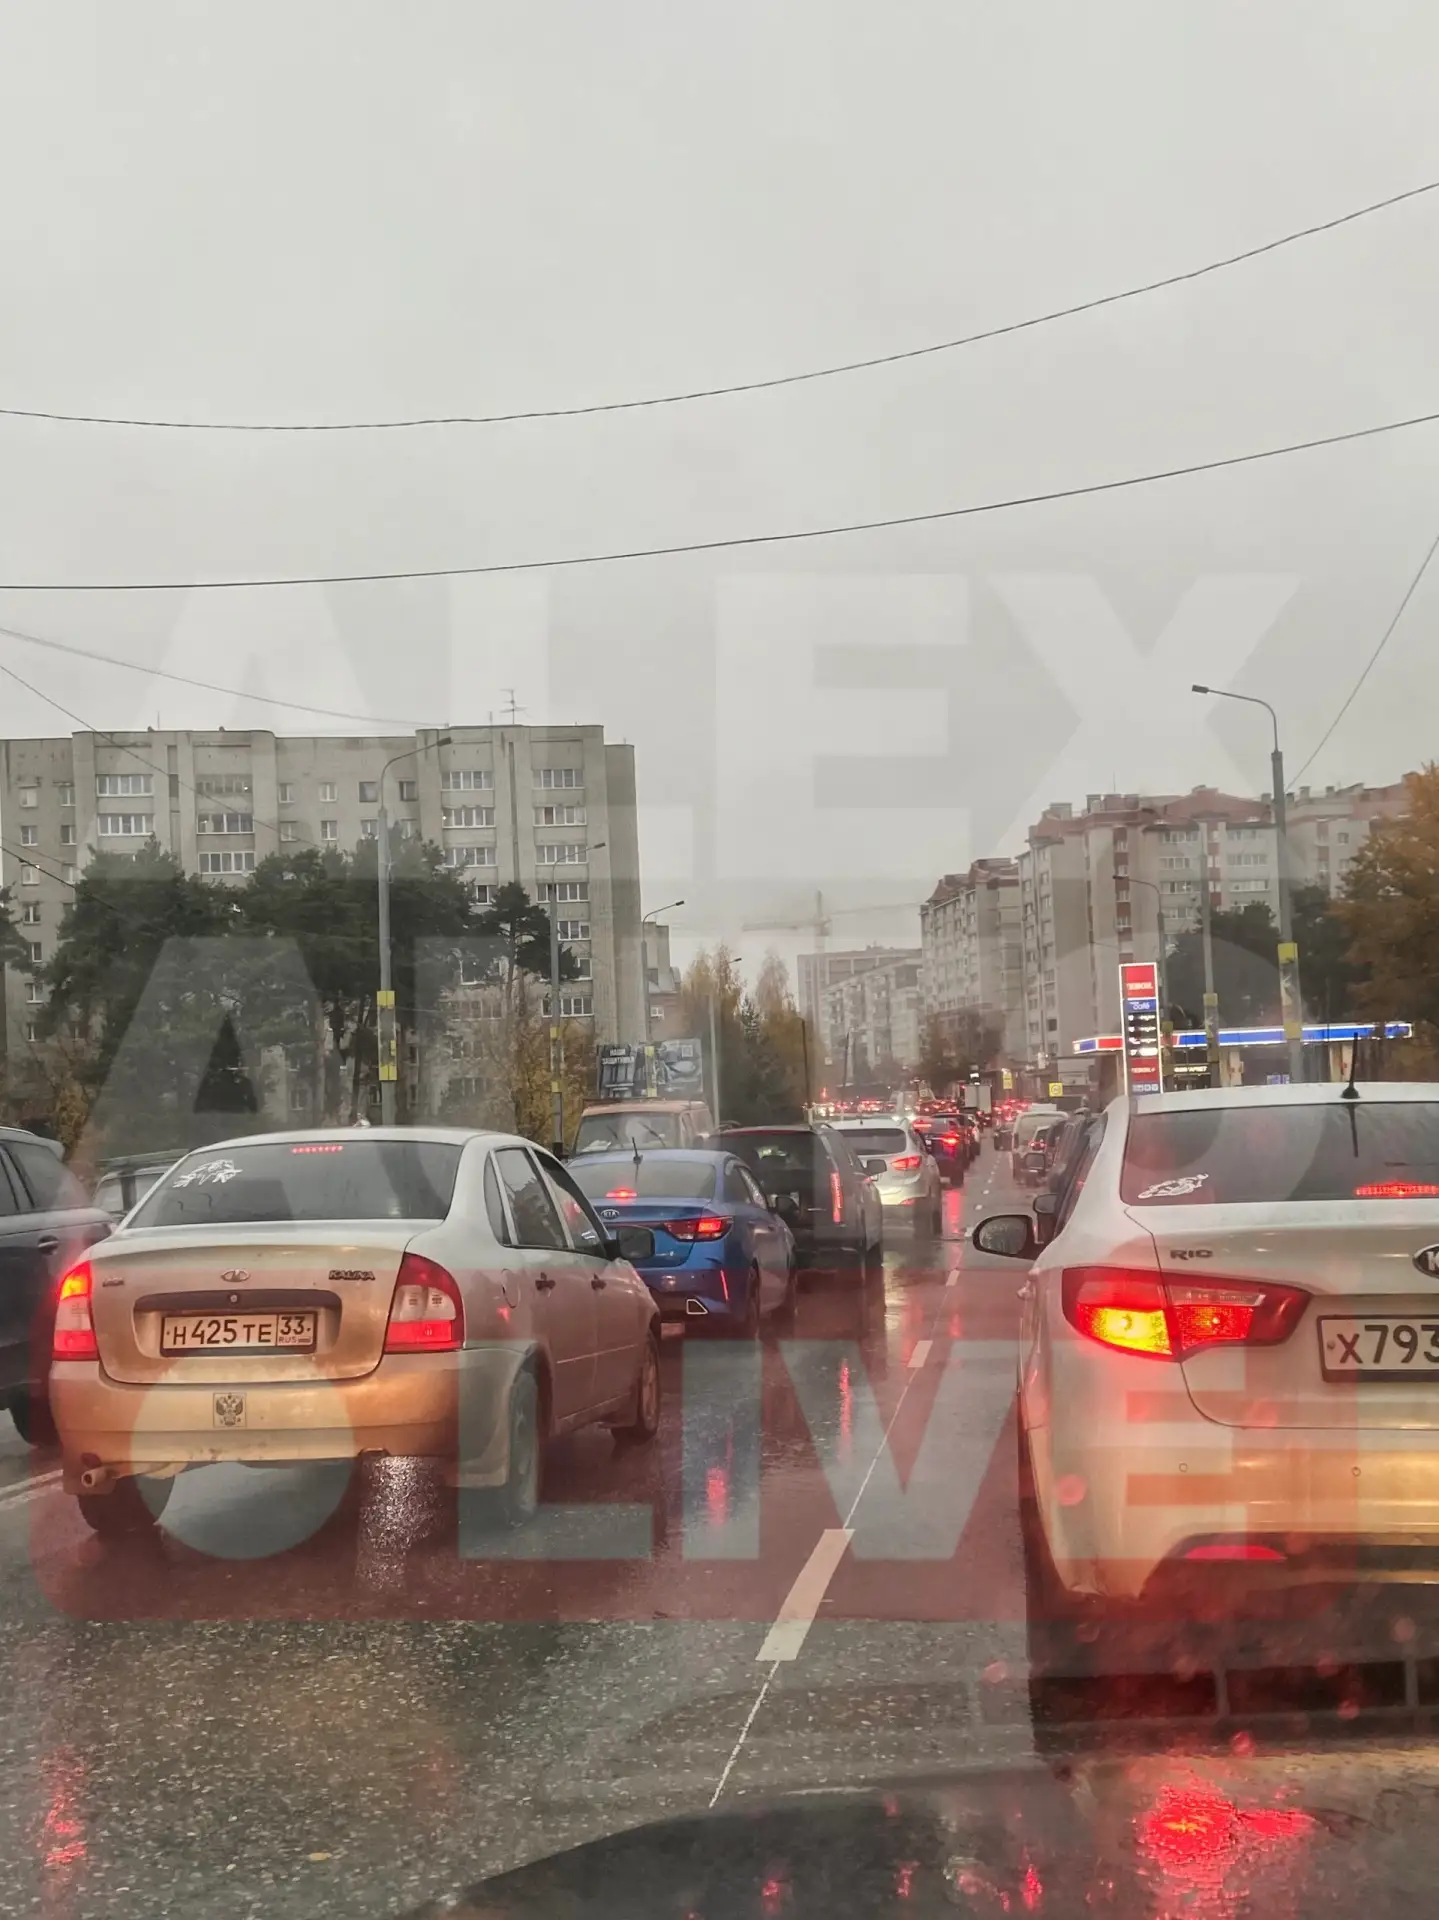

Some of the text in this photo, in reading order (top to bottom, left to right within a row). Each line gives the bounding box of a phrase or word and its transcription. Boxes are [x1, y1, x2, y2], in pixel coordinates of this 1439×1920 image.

[1169, 1249, 1214, 1260] RIO
[328, 1269, 376, 1281] KALINA
[279, 1316, 305, 1335] 33
